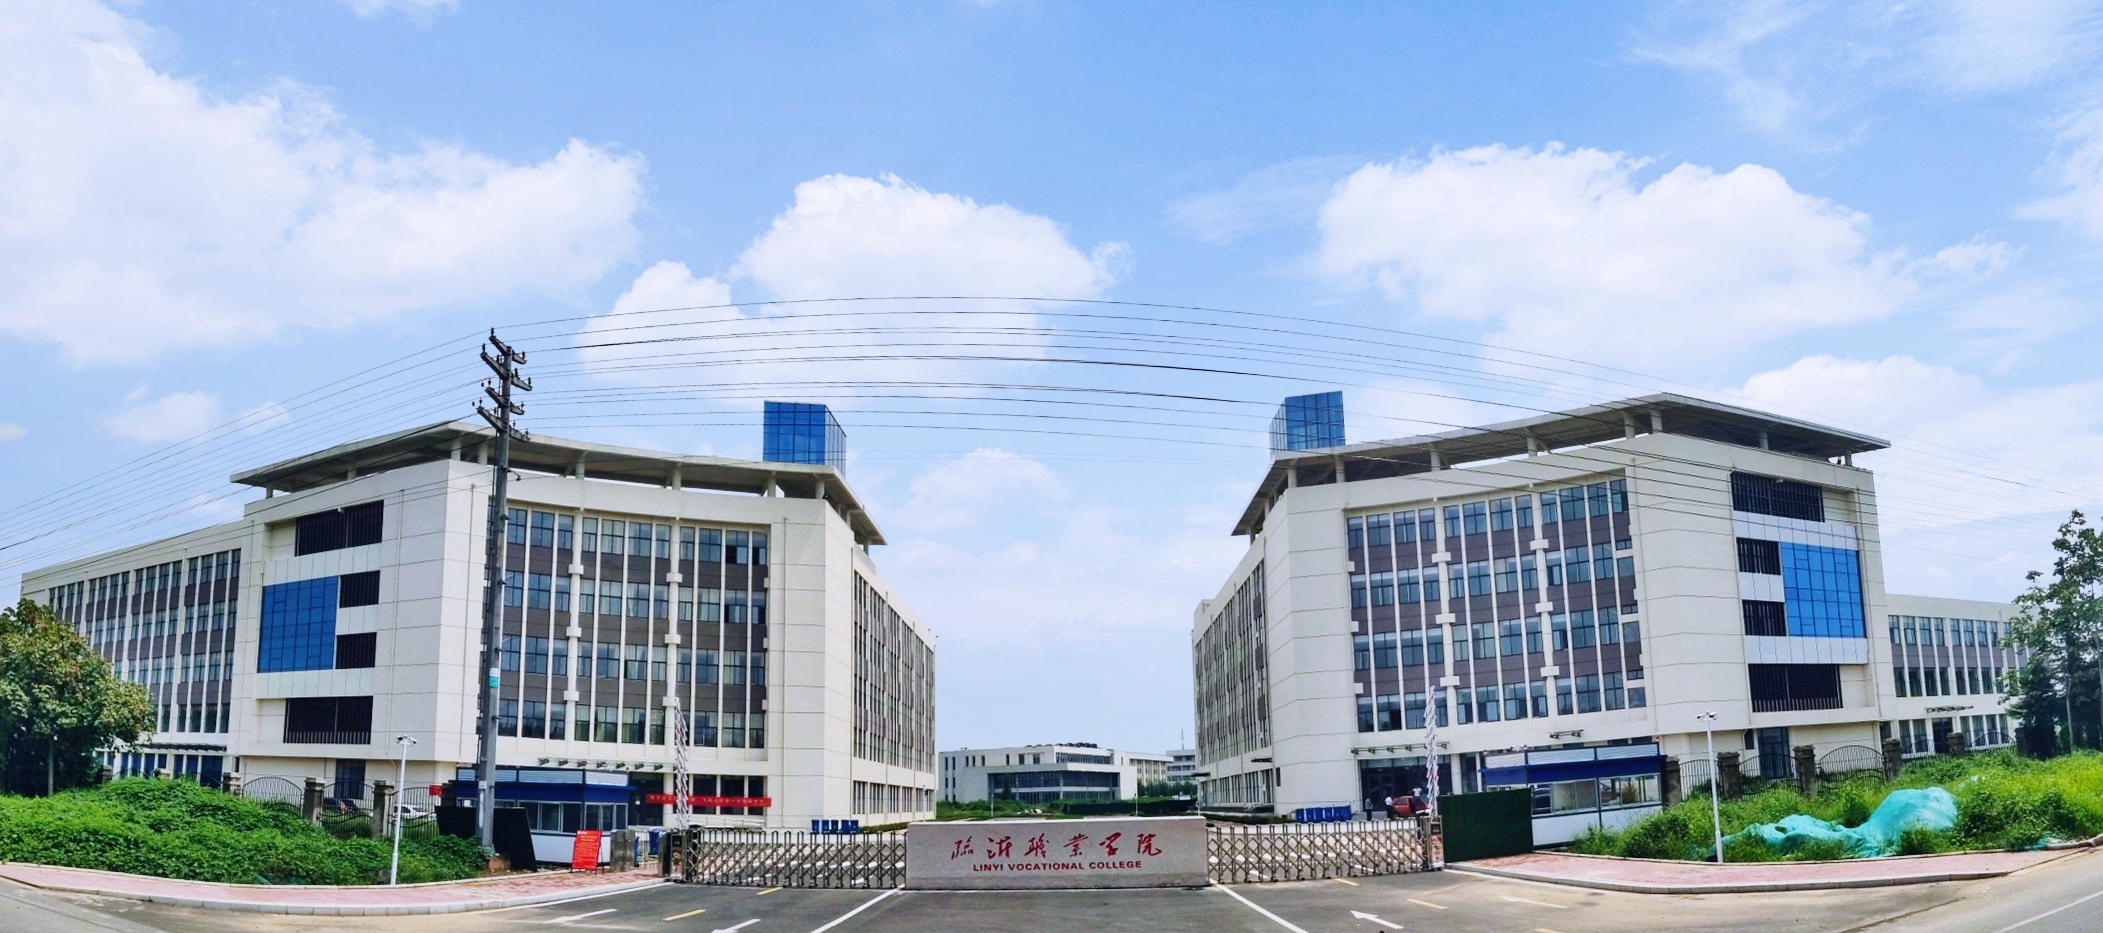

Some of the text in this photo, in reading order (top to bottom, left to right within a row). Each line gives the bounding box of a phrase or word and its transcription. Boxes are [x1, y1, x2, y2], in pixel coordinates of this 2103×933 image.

[973, 861, 1142, 872] LINYI VOCATIONAL COLLEGE
